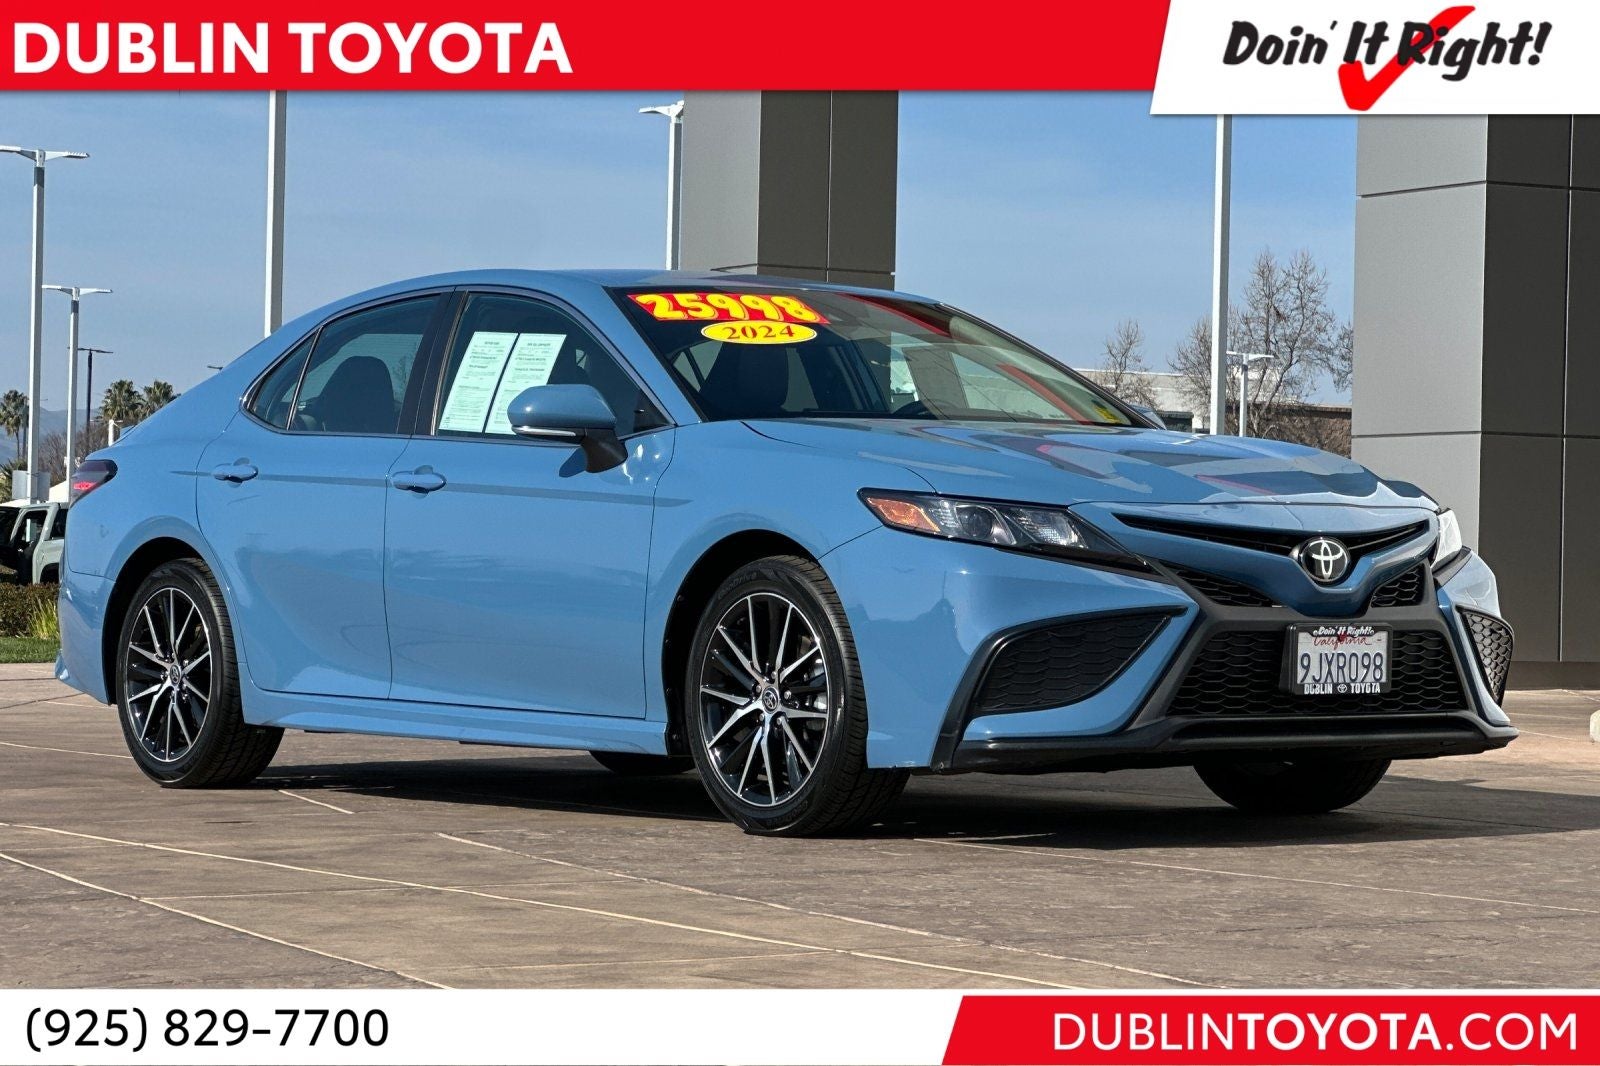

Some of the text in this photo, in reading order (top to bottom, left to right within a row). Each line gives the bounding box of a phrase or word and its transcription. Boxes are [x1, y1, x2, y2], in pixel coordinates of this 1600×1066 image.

[634, 293, 821, 321] 25998
[722, 325, 796, 340] 2024
[1300, 652, 1384, 684] 9JXR098
[1303, 682, 1381, 695] DUBLIN TOYOTA
